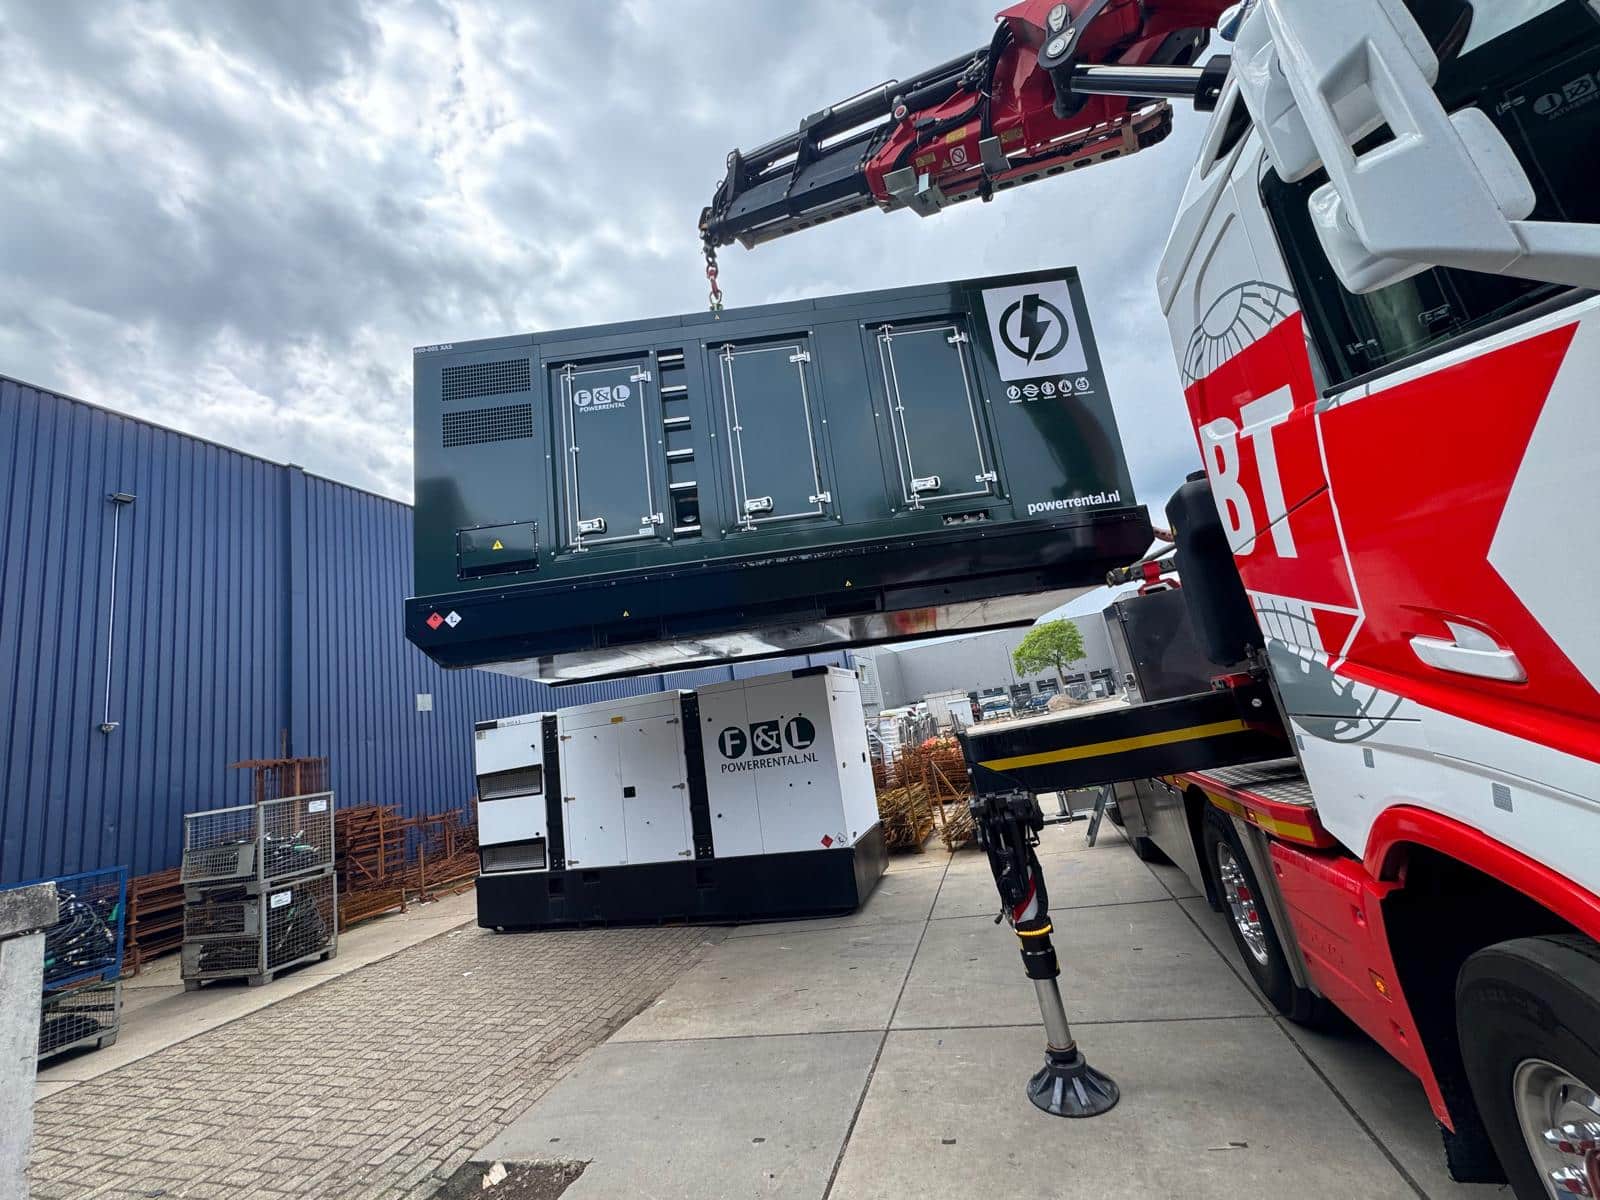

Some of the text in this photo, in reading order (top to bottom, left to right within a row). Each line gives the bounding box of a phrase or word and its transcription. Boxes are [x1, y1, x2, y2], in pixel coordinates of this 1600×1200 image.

[579, 402, 626, 413] POWERRENTAL
[1199, 384, 1298, 559] BT
[1027, 489, 1121, 515] powerrental.nl
[721, 752, 819, 774] POWERRENTAL.NL
